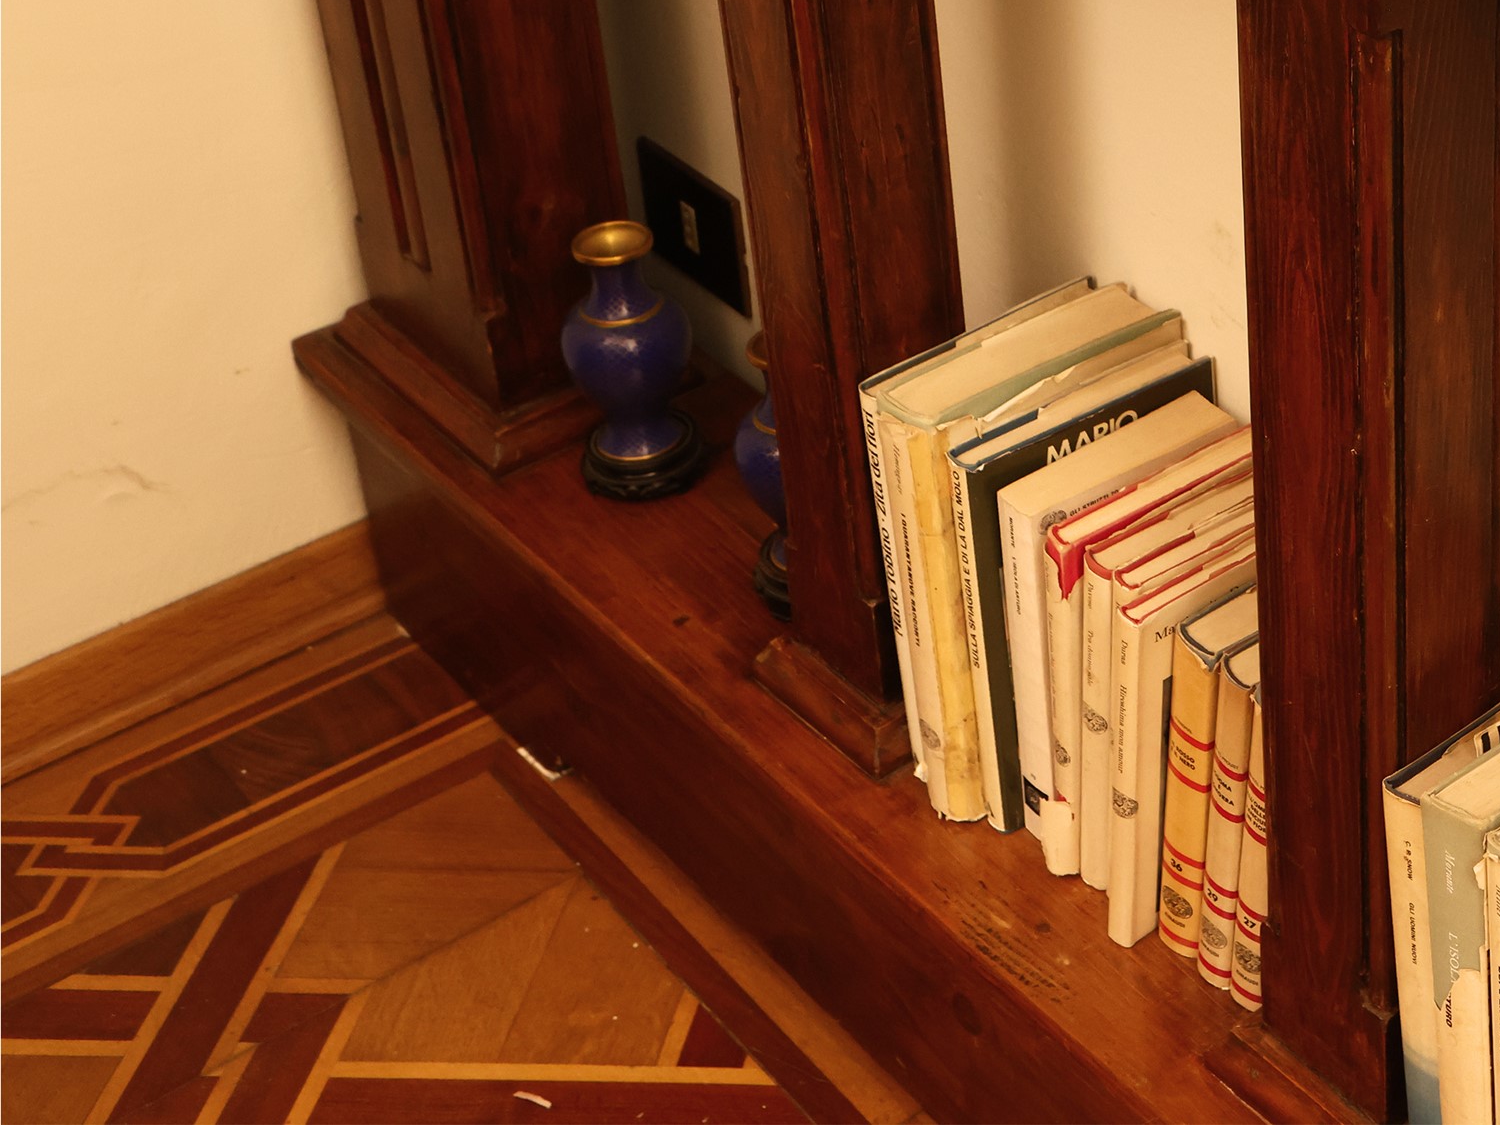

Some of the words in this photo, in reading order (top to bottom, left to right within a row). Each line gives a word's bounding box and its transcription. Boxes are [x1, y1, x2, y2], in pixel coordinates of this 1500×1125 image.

[862, 408, 877, 448] fiori
[1046, 409, 1138, 466] MARIO
[869, 448, 881, 478] dei
[875, 480, 887, 516] Zita
[952, 470, 962, 506] MOLO
[957, 509, 966, 532] DAL
[881, 527, 896, 585] Tobino
[961, 551, 969, 565] DI
[962, 565, 970, 575] E
[890, 588, 903, 637] Mario
[964, 578, 976, 631] SPIAGGIA
[910, 598, 921, 648] RACCONTI
[970, 633, 980, 669] SULLA
[1120, 639, 1129, 666] Duras
[1119, 683, 1128, 727] Hiroshima
[1118, 728, 1126, 745] mon
[1117, 746, 1126, 774] amour
[1250, 804, 1266, 819] DELL
[1253, 821, 1267, 833] FIOR
[1170, 858, 1183, 872] 36
[1406, 859, 1414, 881] SNOW
[1206, 887, 1218, 902] 29
[1408, 901, 1416, 915] GLI
[1243, 916, 1256, 929] 27
[1409, 916, 1417, 942] UOMINI
[1410, 943, 1418, 966] NUOVI
